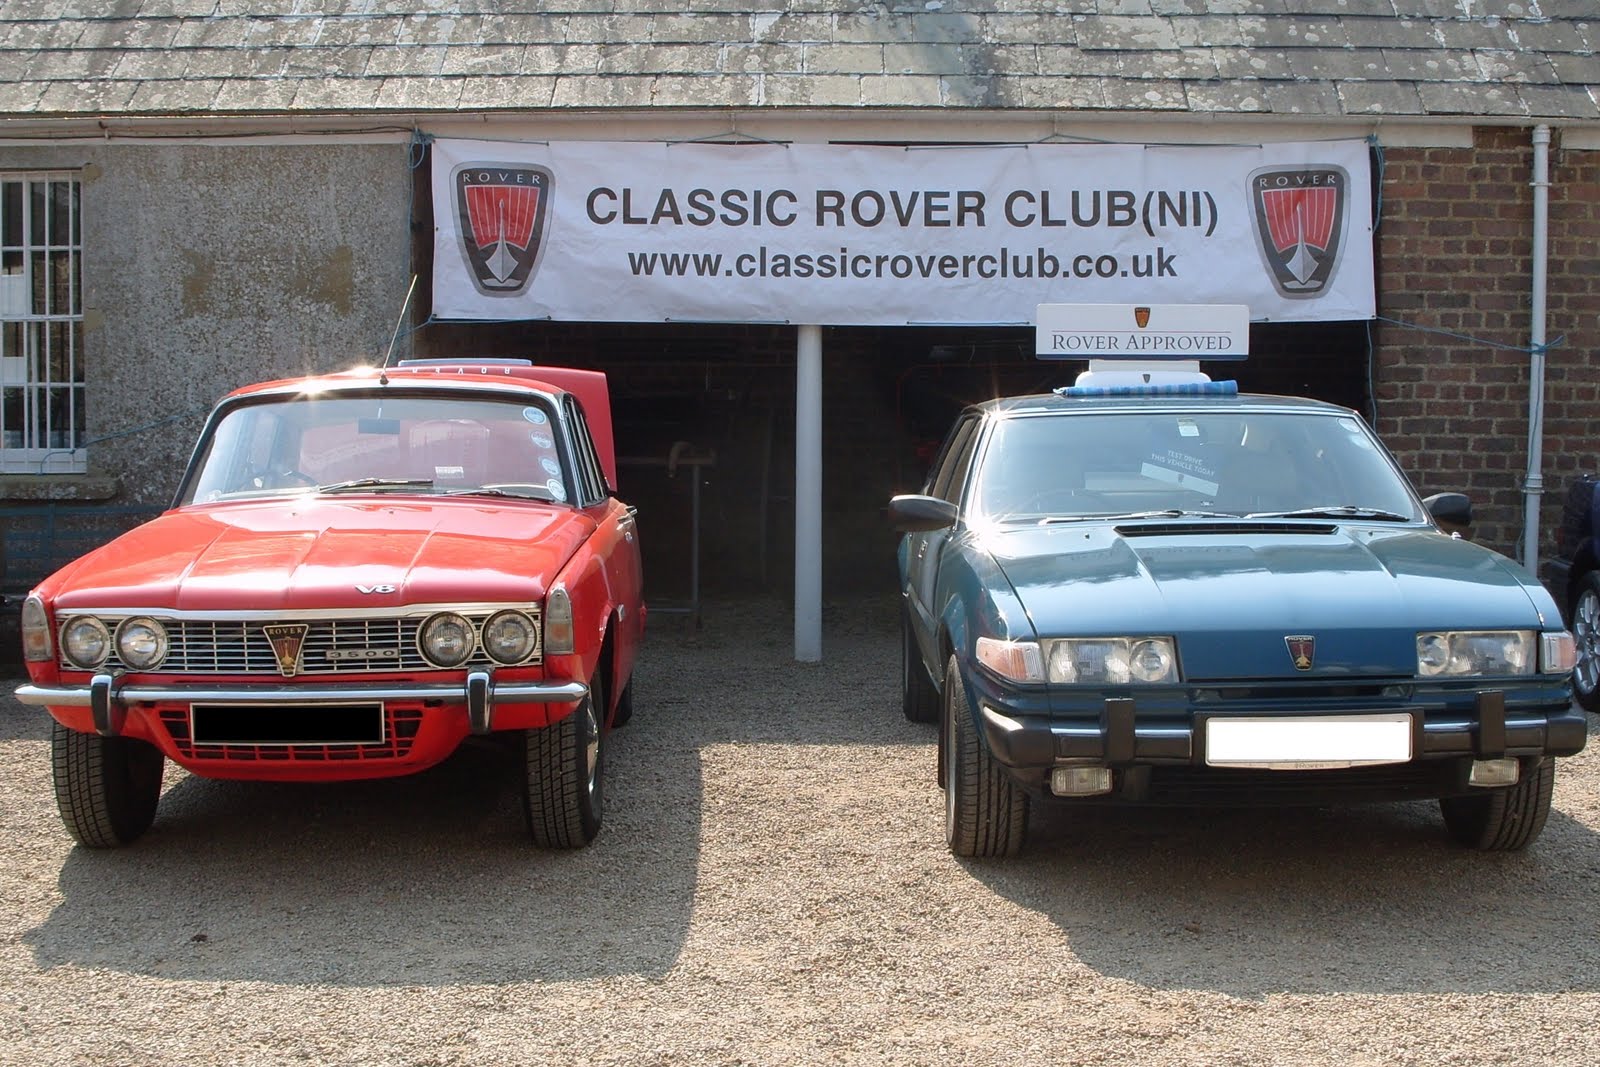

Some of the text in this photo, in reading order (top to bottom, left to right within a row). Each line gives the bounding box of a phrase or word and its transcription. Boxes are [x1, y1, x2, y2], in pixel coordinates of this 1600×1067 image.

[463, 172, 541, 185] ROVER
[1259, 174, 1336, 187] ROVER
[586, 187, 1218, 237] CLASSIC ROVER CLUB(NI)
[628, 246, 1177, 279] www.classicroverclub.co.uk
[1167, 449, 1203, 465] TEST DRIVE
[1151, 453, 1215, 477] THIS VEHICLE TODAY
[355, 584, 396, 594] V8
[269, 627, 303, 635] ROVER
[330, 650, 395, 658] 3500
